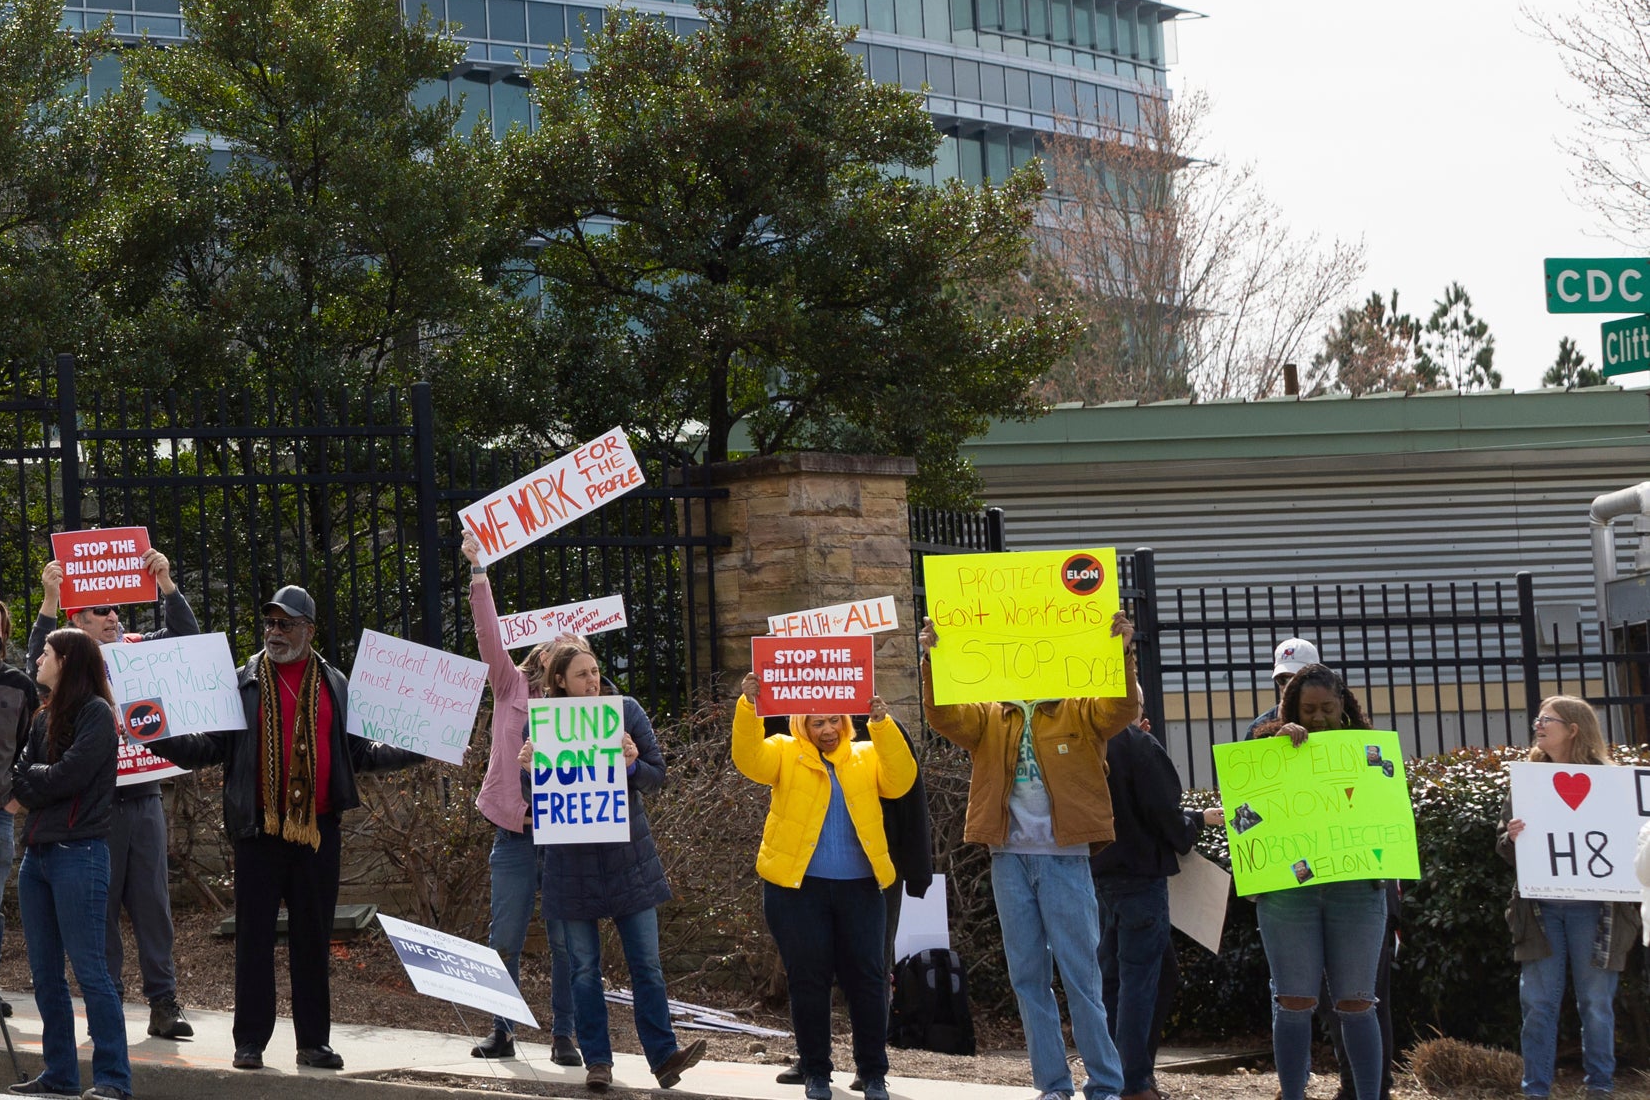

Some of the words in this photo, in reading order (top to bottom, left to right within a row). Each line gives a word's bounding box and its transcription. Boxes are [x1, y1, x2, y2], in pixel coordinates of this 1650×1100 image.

[1556, 269, 1644, 303] CDC
[574, 435, 623, 469] FOR
[578, 452, 626, 482] THE
[585, 466, 640, 506] PEOPLE
[465, 498, 518, 556] WE
[507, 468, 582, 537] WORK
[73, 541, 108, 557] STOP
[110, 539, 136, 554] THE
[72, 574, 141, 592] TAKEOVER
[957, 564, 1056, 596] PROTECT
[1066, 569, 1098, 580] ELON
[500, 614, 537, 646] JESUS
[572, 609, 599, 634] HEALTH
[585, 612, 623, 633] WORKER
[772, 612, 831, 636] HEALTH
[832, 616, 844, 626] for
[844, 602, 892, 632] ALL
[111, 641, 189, 680] Deport
[363, 633, 429, 676] President
[774, 649, 816, 664] STOP
[820, 648, 851, 663] THE
[950, 639, 1055, 685] STOP
[176, 662, 231, 695] Musk
[763, 666, 864, 683] BILLIONAIRE
[360, 670, 393, 691] must
[397, 676, 414, 698] be
[418, 682, 477, 716] stopped
[771, 685, 856, 700] TAKEOVER
[130, 713, 161, 728] ELON
[168, 696, 218, 727] NOW
[348, 689, 430, 735] Reinstate
[531, 704, 620, 743] FUND
[361, 719, 430, 754] Workers
[533, 744, 623, 786] DON'T
[1310, 737, 1366, 775] ELON
[532, 790, 626, 830] FREEZE
[1267, 784, 1355, 825] NOW!
[1236, 830, 1319, 873] NOBODY
[1328, 823, 1412, 851] ELECTED
[1314, 848, 1384, 879] ELON!
[1547, 830, 1614, 878] H8
[398, 940, 425, 956] THE
[426, 948, 458, 966] CDC
[460, 958, 501, 980] SAVES
[440, 963, 477, 983] LIVES
